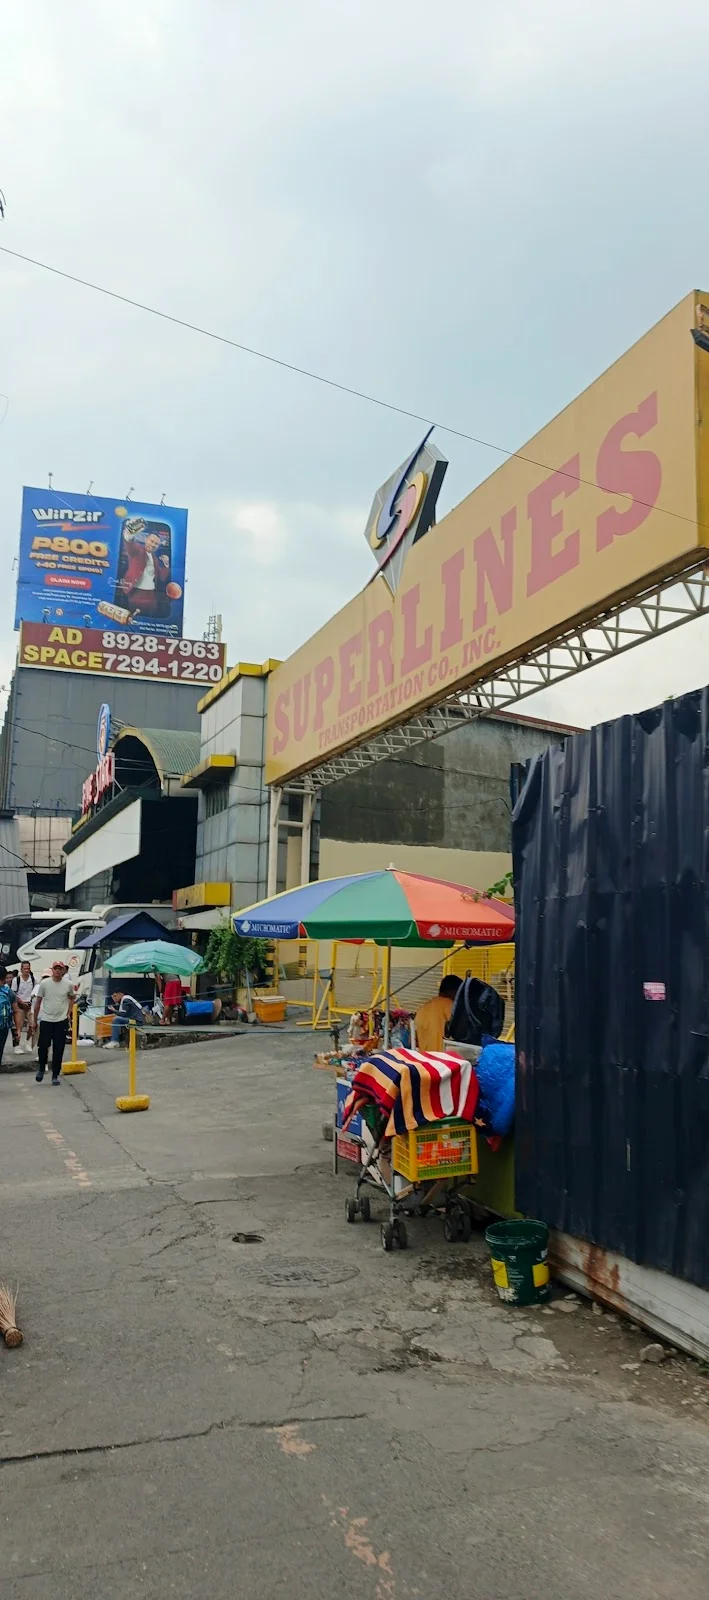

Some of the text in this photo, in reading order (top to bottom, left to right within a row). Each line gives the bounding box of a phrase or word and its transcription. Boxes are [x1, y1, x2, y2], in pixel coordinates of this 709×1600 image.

[32, 536, 109, 558] P800
[29, 552, 110, 568] FREE CREDITS
[35, 561, 56, 569] +40
[271, 390, 662, 756] SUPERLINES
[48, 627, 83, 645] AD
[102, 631, 220, 660] 8928-7963
[23, 645, 104, 668] SPACE
[102, 653, 223, 682] 7294-1220
[317, 674, 424, 749] TRANSPORTATION
[461, 625, 501, 668] INC.
[251, 923, 291, 934] MICROMATIC
[444, 926, 502, 937] MICROMATIC
